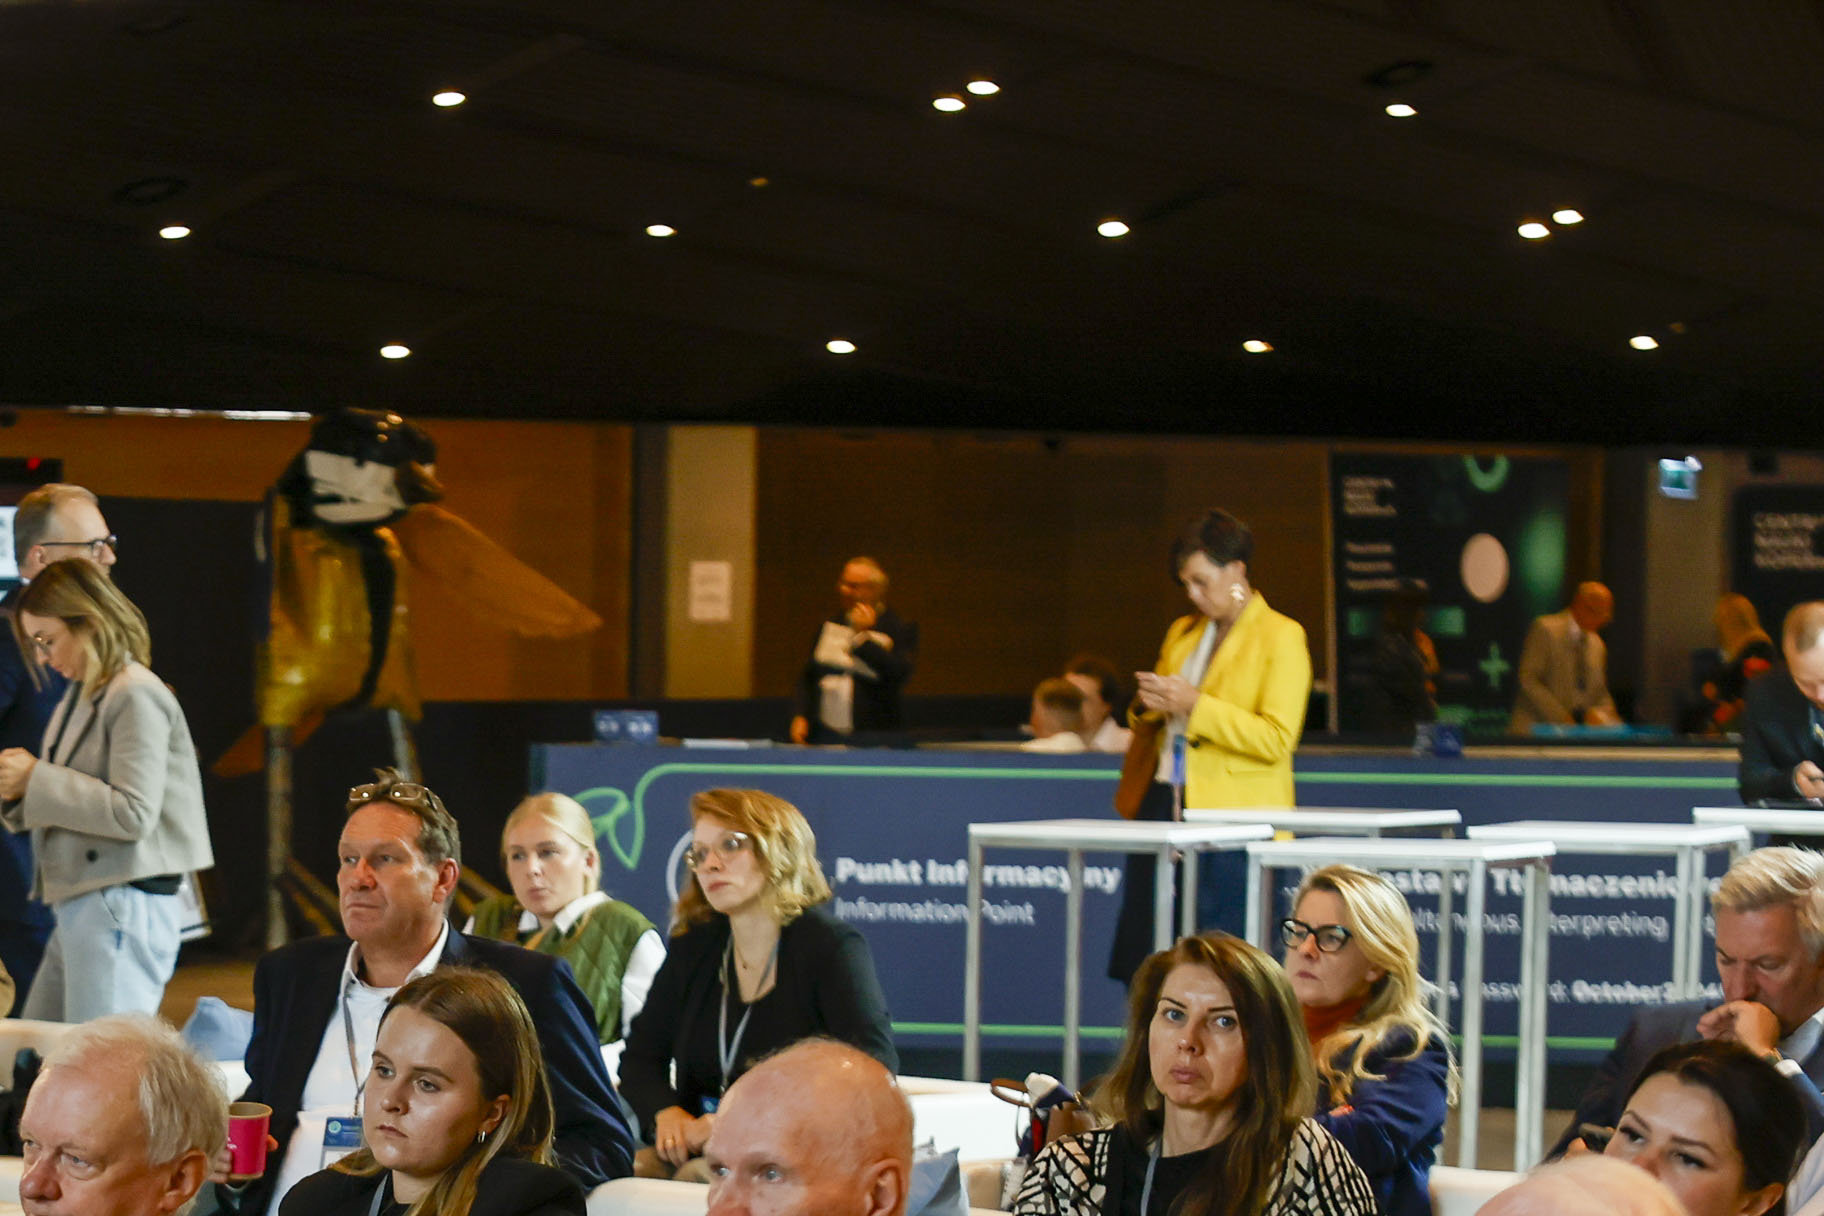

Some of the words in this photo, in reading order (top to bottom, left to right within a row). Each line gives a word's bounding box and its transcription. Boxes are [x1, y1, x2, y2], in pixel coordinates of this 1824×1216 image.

[836, 857, 922, 885] Punkt
[927, 858, 1122, 894] Infrmacyny
[835, 897, 968, 923] Information
